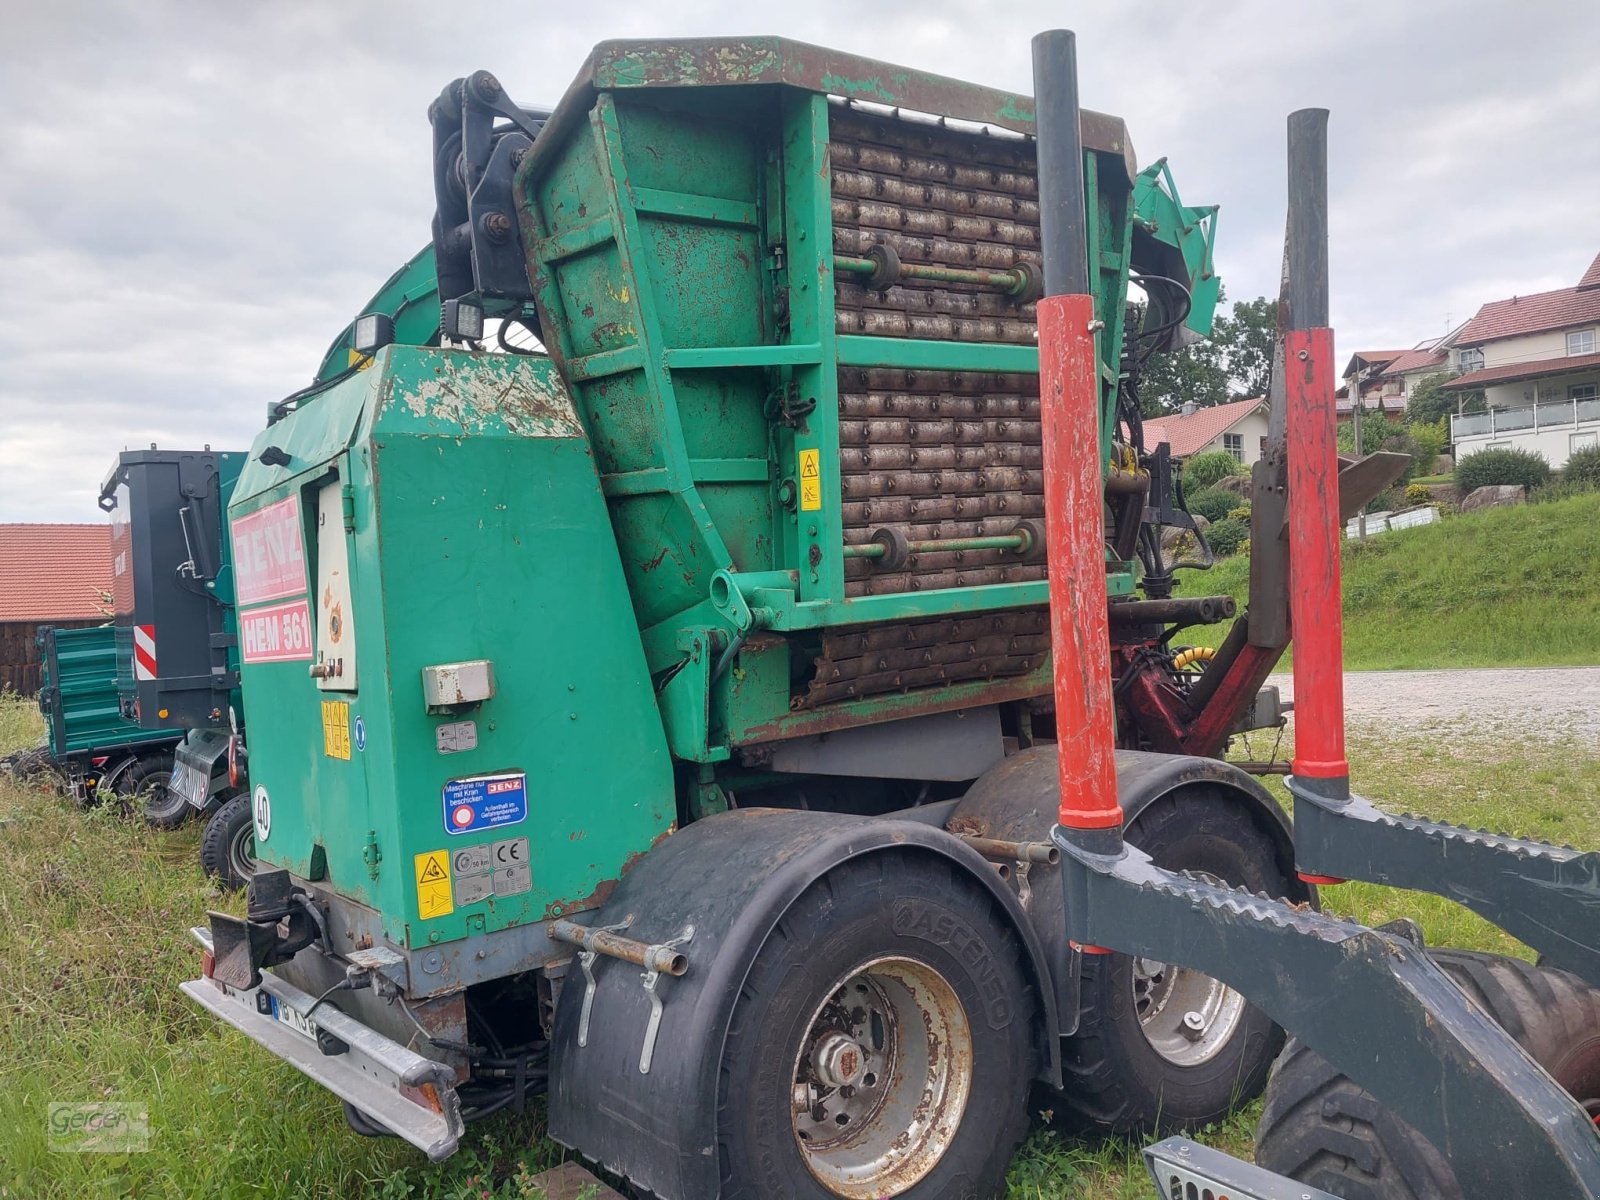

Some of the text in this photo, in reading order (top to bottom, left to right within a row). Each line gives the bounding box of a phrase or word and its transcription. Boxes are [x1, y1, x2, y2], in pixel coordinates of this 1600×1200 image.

[236, 516, 301, 577] JENZ
[245, 611, 310, 653] HEM 561
[449, 795, 483, 806] beschicken
[463, 789, 479, 797] Kran
[490, 781, 520, 792] JENZ
[257, 795, 268, 831] 40
[911, 908, 1009, 1023] ASCENSO
